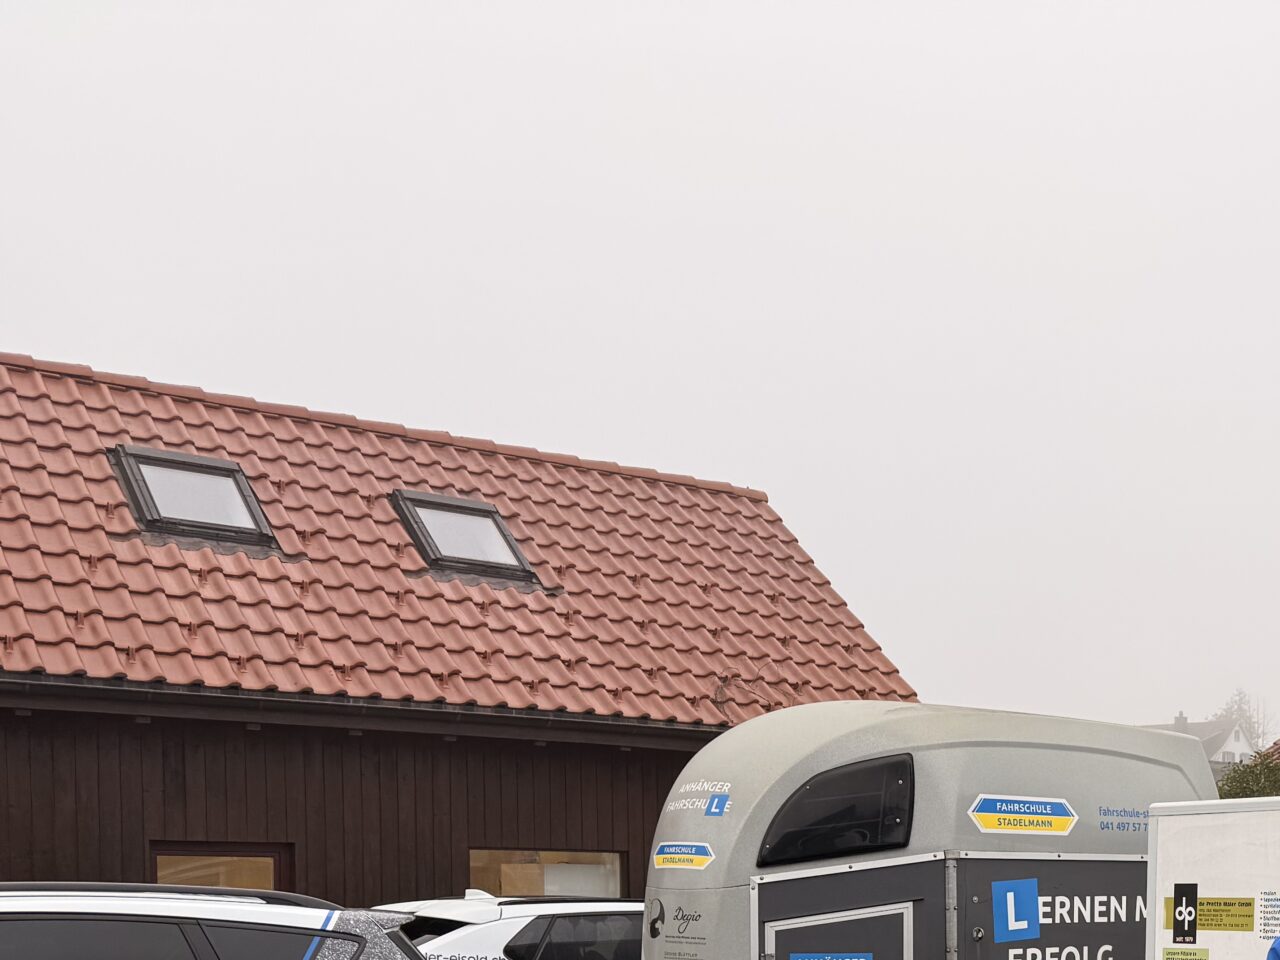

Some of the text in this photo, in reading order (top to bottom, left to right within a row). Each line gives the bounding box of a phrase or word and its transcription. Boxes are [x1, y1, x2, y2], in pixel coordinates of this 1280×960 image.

[679, 779, 731, 793] ANHÄNGER
[996, 802, 1052, 814] FAHRSCHULE
[997, 817, 1053, 828] STADELMANN
[1100, 821, 1114, 831] 041
[1116, 822, 1130, 831] 497
[1132, 822, 1141, 832] 57
[1006, 891, 1127, 931] LERNEN
